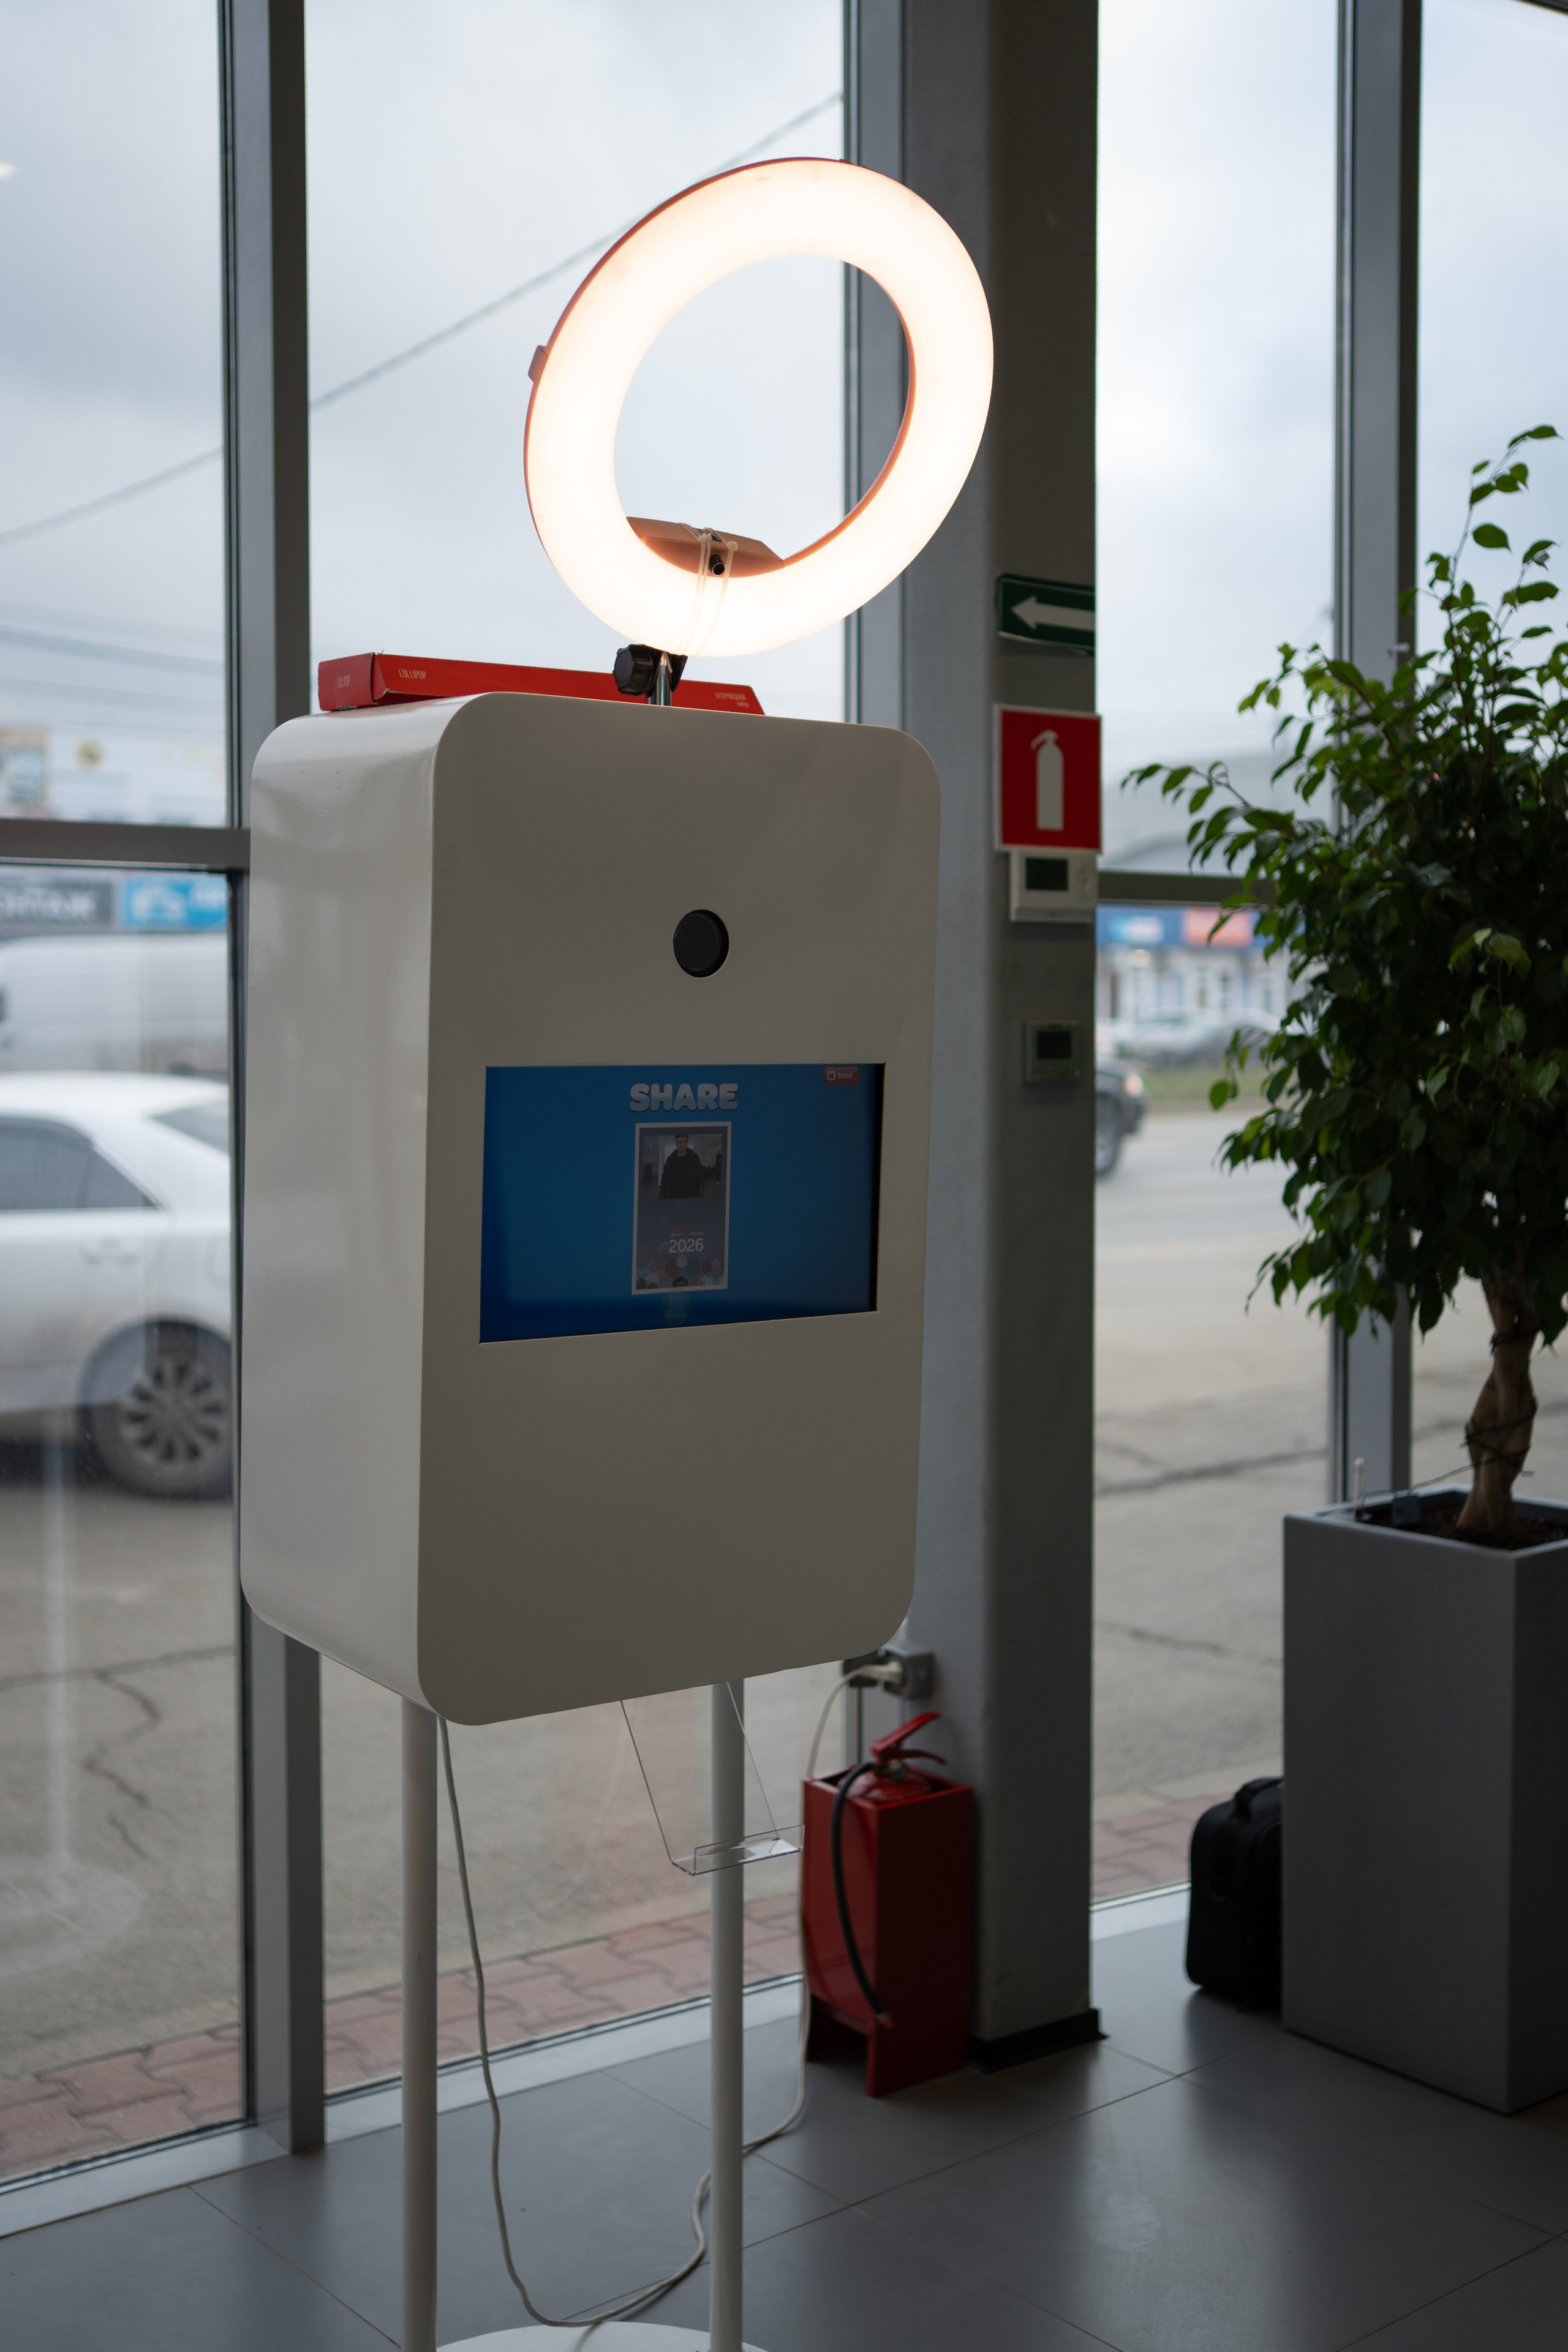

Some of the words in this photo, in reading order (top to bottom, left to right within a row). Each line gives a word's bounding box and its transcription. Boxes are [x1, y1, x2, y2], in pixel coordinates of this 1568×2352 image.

[398, 669, 426, 679] LOLLIPOP
[630, 1083, 739, 1112] SHARE
[668, 1238, 704, 1253] 2026
